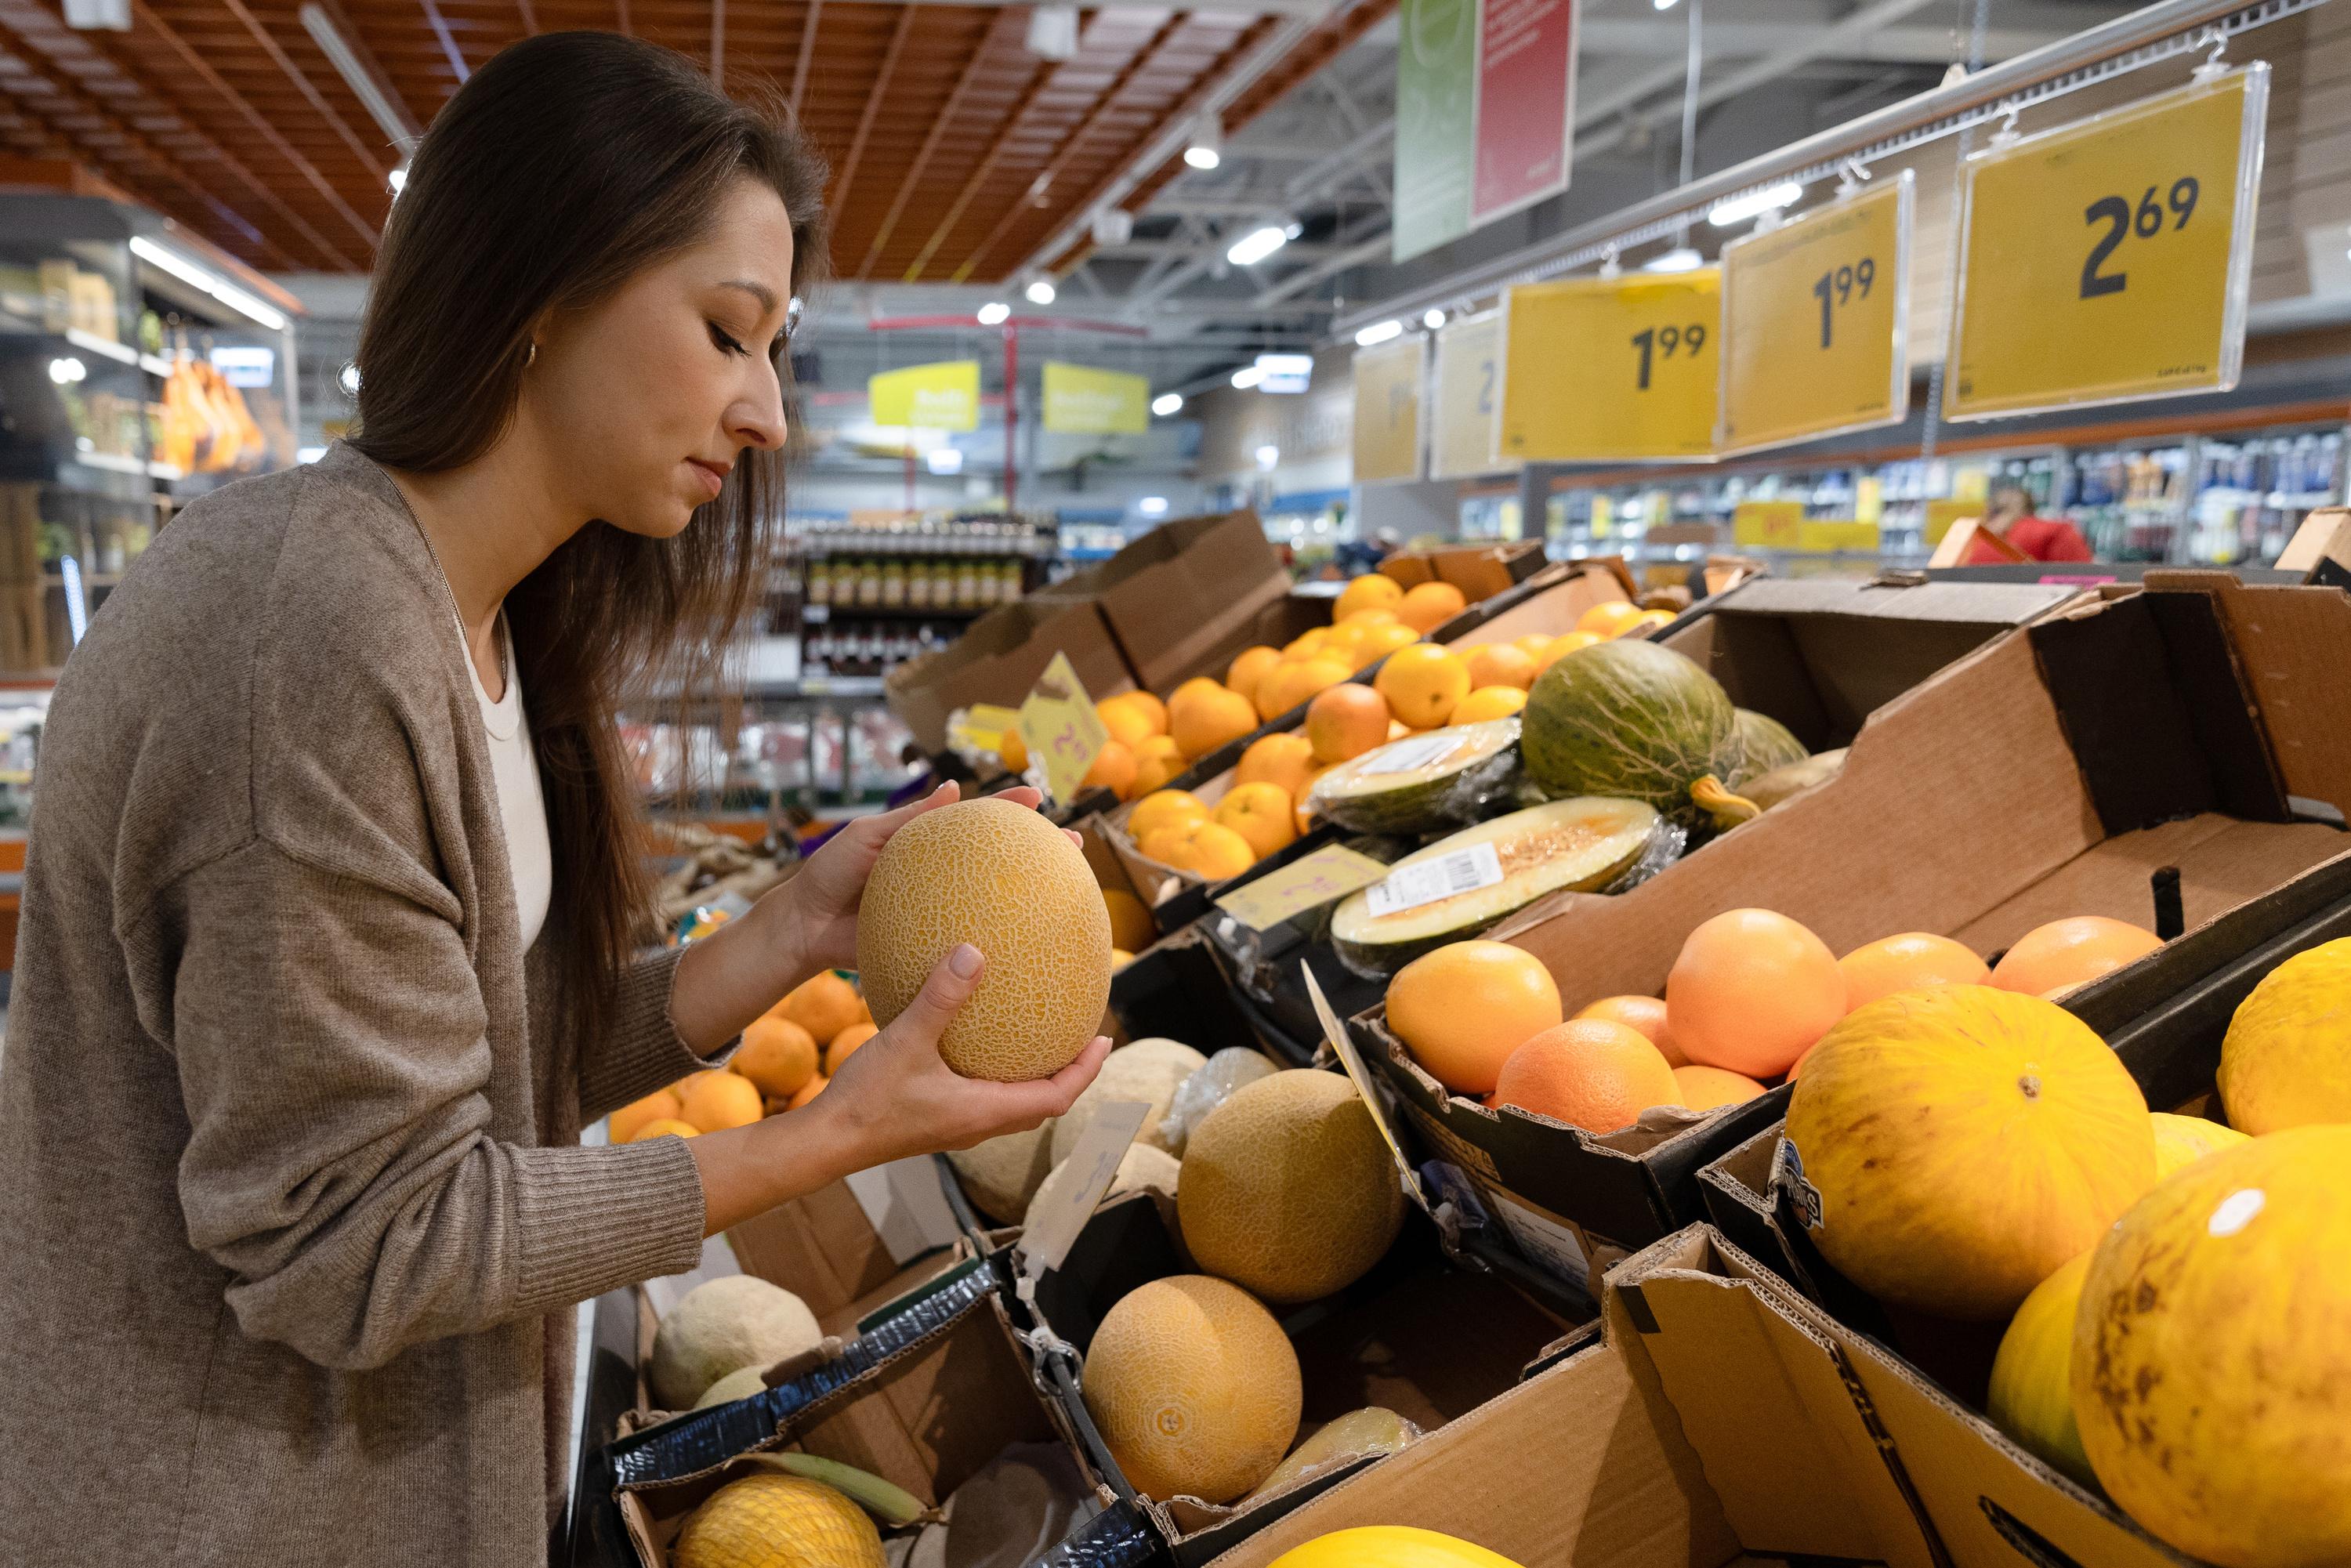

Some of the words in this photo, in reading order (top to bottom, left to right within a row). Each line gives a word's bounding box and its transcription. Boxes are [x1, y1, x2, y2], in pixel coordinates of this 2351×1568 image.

[2079, 176, 2200, 299] 269
[1813, 257, 1875, 349] 199
[1632, 324, 1706, 390] 199
